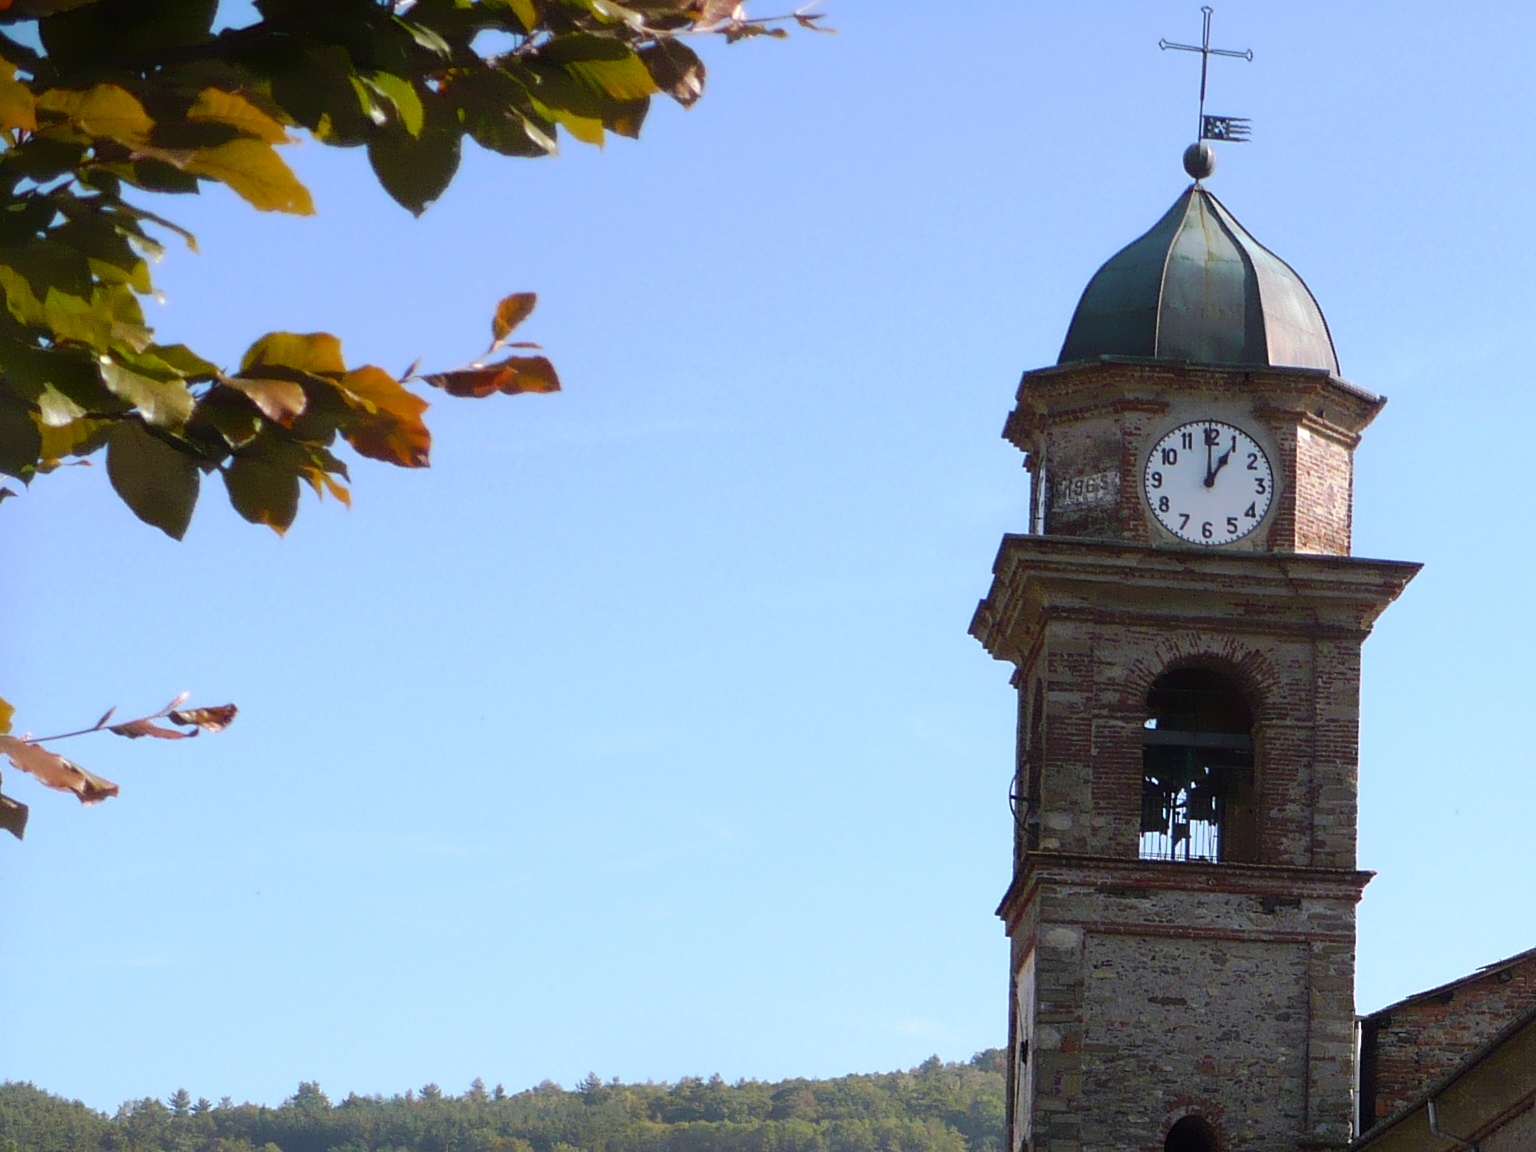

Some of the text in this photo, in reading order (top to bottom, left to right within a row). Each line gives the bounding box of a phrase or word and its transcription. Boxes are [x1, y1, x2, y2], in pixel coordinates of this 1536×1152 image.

[1181, 432, 1193, 450] 11
[1203, 428, 1220, 446] 12
[1231, 435, 1236, 453] 1
[1161, 447, 1178, 466] 10
[1246, 453, 1258, 470] 2
[1151, 471, 1162, 489] 9
[1254, 477, 1266, 495] 3
[1158, 496, 1169, 513] 8
[1244, 501, 1256, 518] 4
[1178, 513, 1190, 530] 7
[1201, 521, 1213, 539] 6
[1226, 517, 1238, 534] 5
